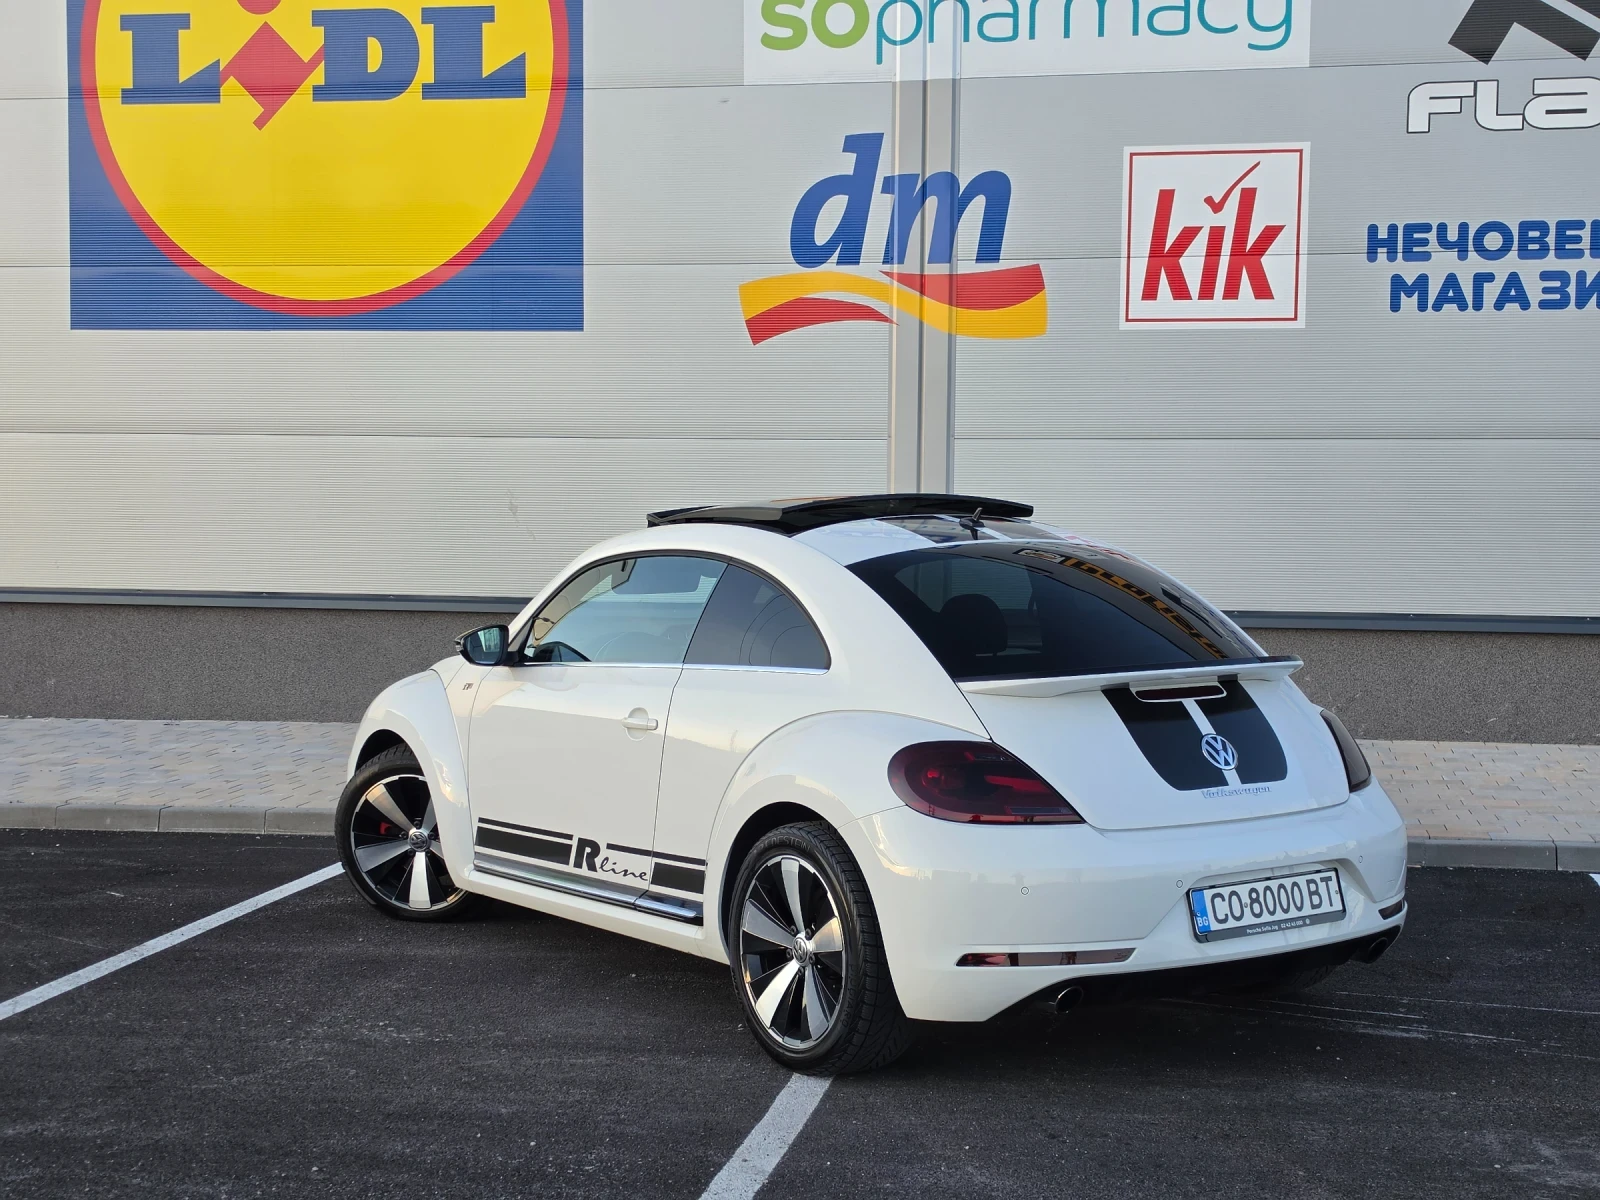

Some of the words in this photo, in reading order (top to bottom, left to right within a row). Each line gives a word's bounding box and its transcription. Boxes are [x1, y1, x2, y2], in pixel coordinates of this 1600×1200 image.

[790, 132, 1012, 269] dm
[1141, 161, 1287, 301] kik
[1366, 219, 1600, 263] НЕЧОВЕ
[1201, 785, 1271, 799] Volkswagen
[1196, 916, 1209, 927] BG
